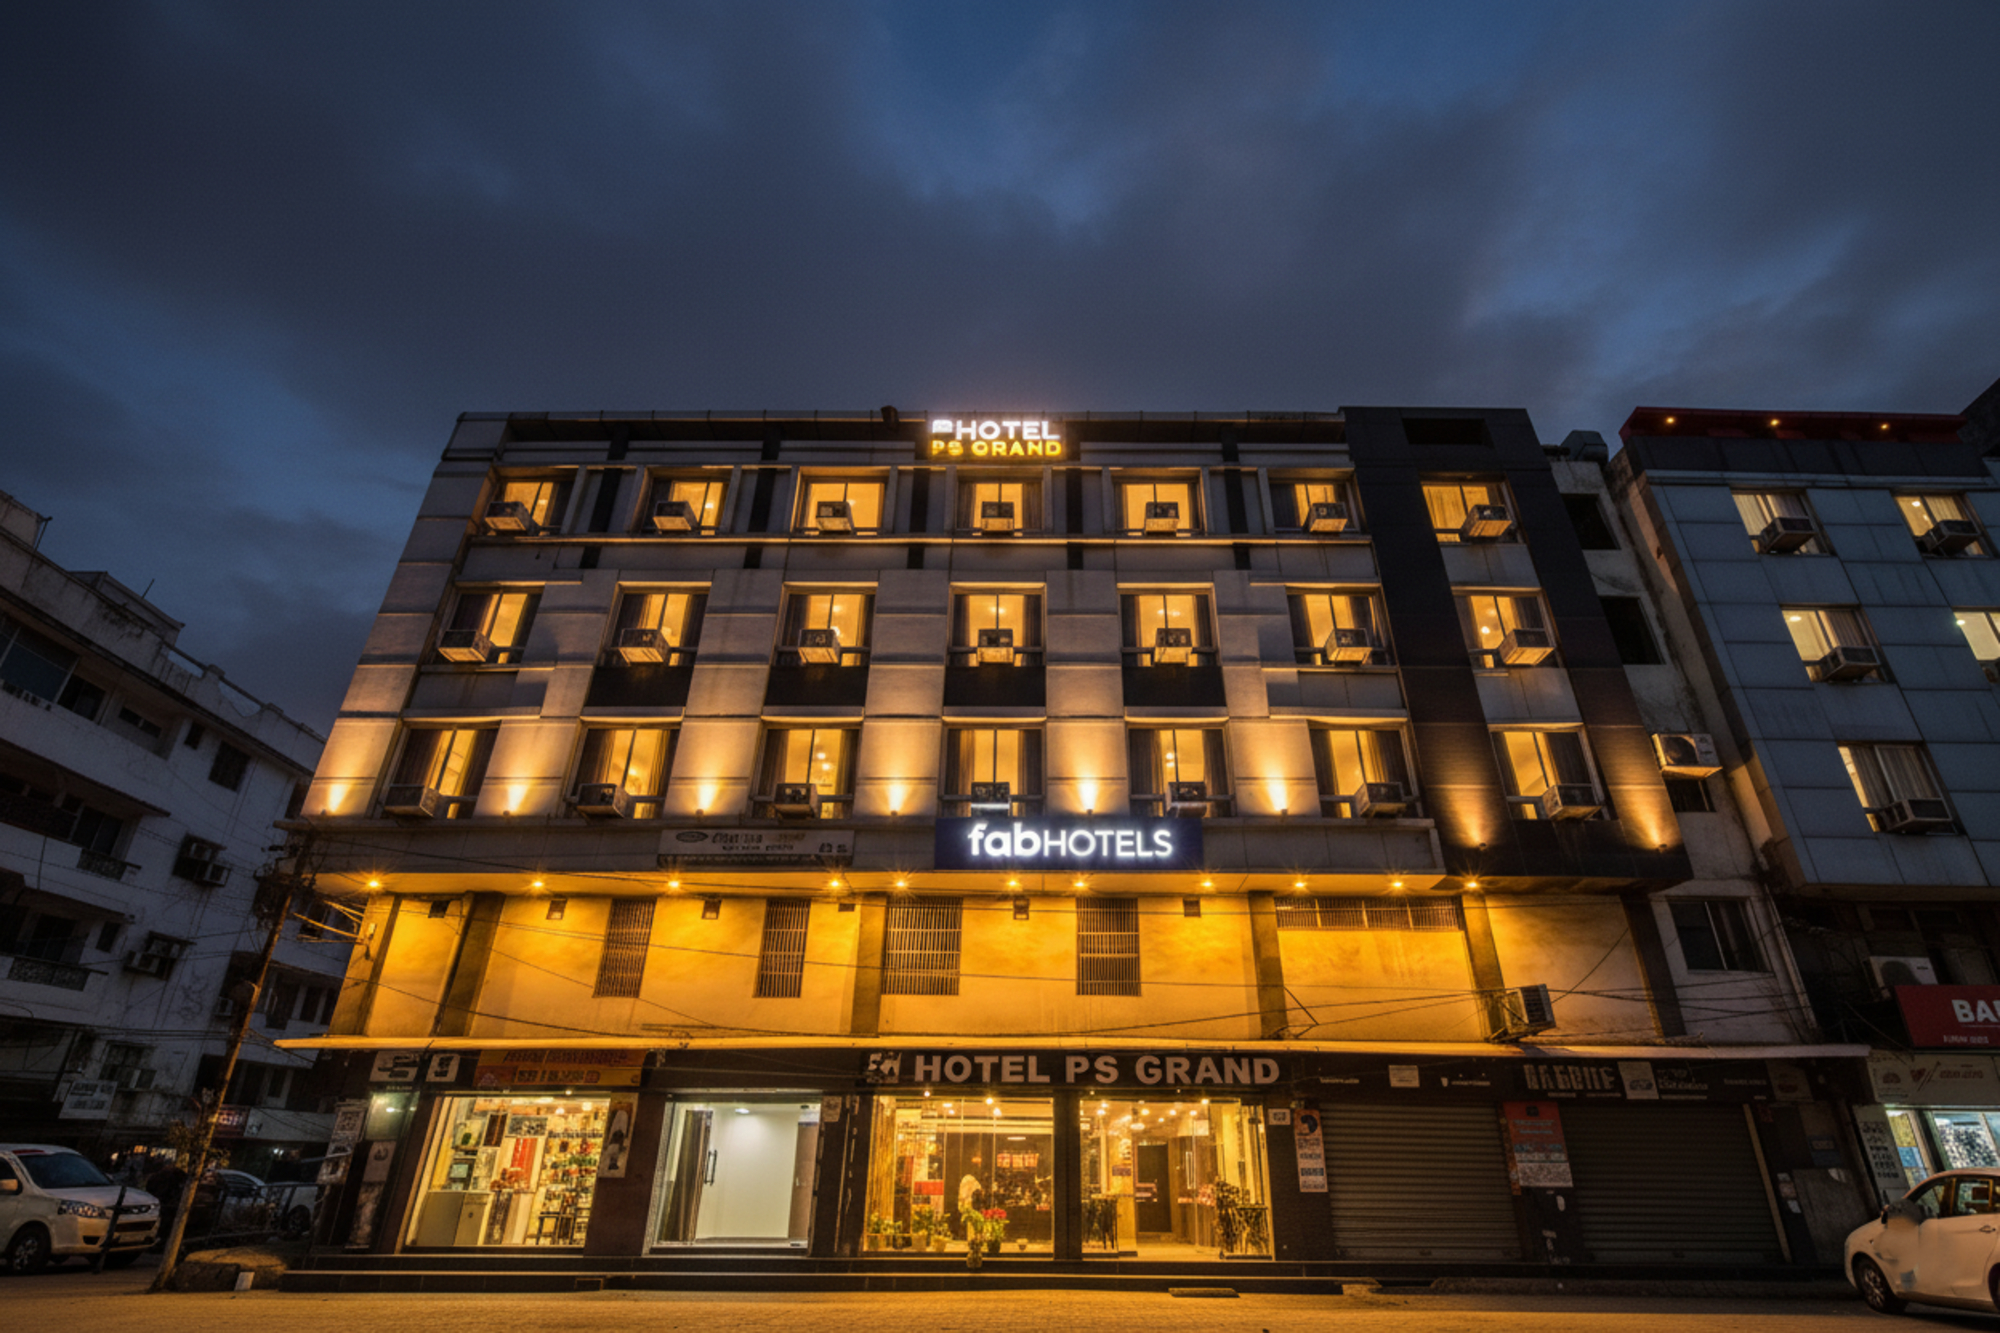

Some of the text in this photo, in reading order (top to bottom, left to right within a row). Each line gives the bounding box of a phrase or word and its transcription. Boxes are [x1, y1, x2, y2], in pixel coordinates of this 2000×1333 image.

[955, 420, 1060, 440] HOTEL
[932, 440, 963, 456] PS
[914, 1055, 1280, 1084] HOTEL PS GRAND
